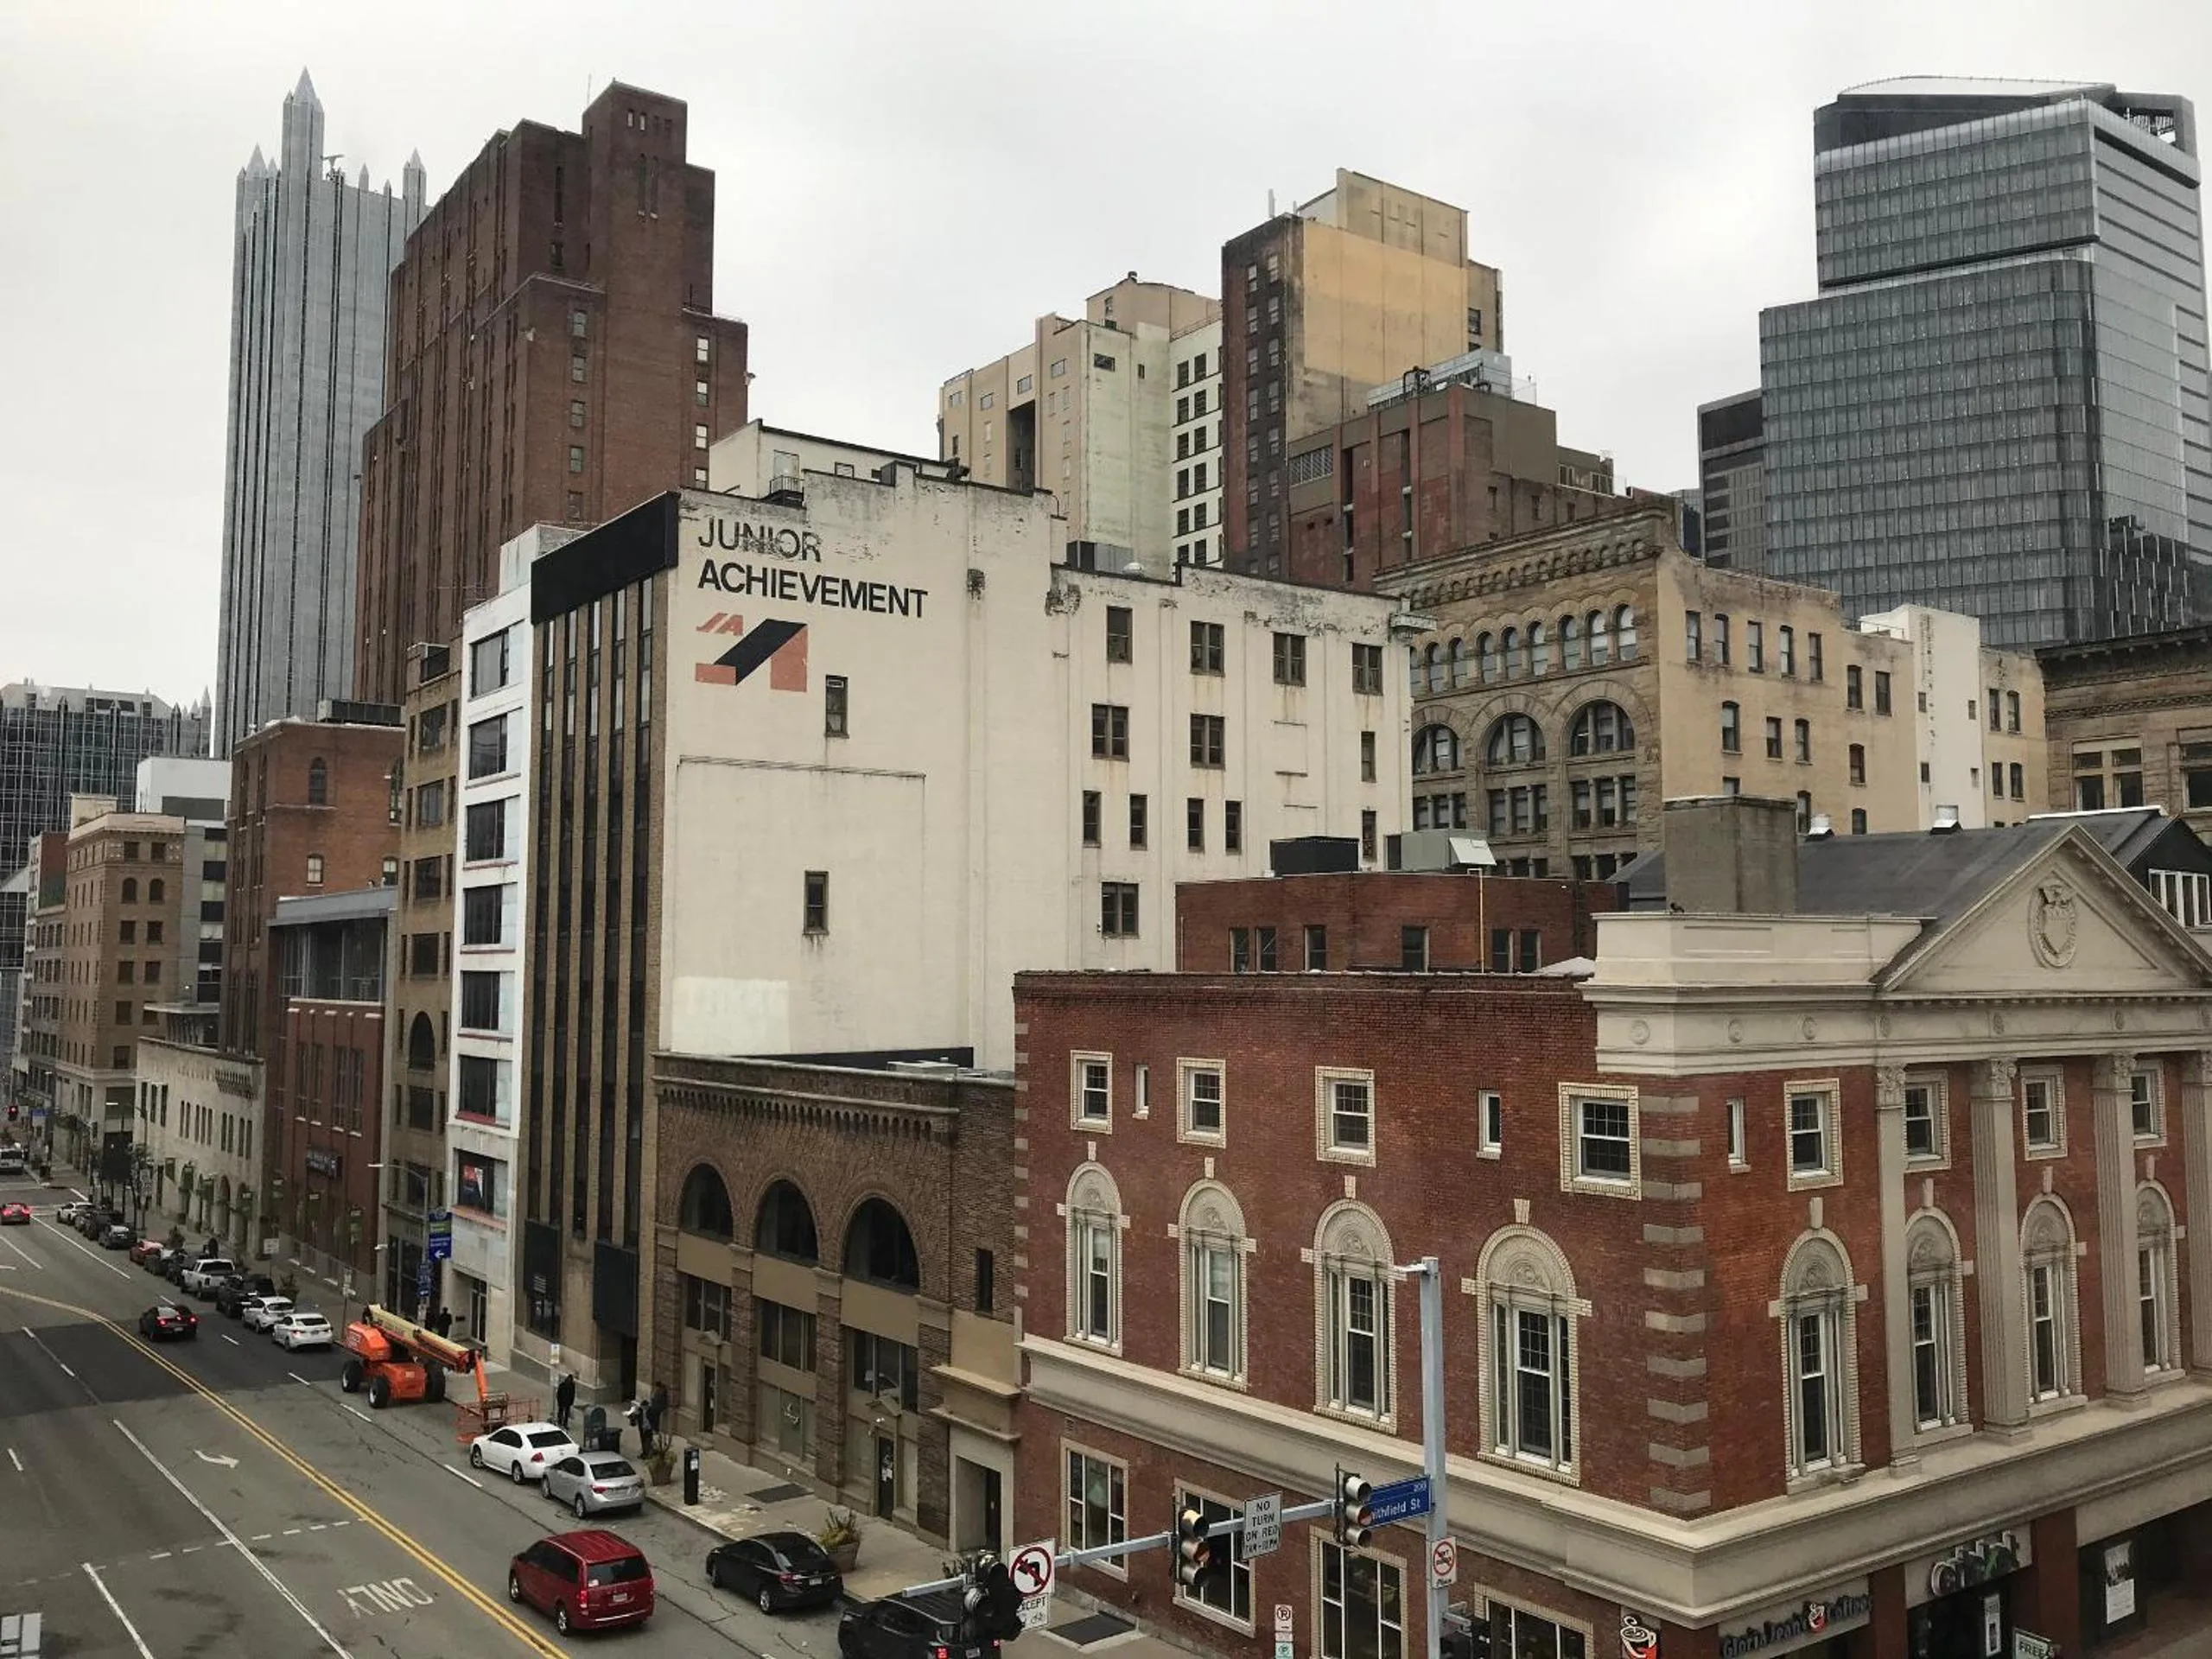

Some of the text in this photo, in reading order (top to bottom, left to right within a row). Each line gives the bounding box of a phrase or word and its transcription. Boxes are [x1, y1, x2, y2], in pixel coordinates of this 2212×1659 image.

[698, 518, 822, 563] JUNIOR
[697, 559, 928, 618] ACHIEVEMENT
[1256, 1501, 1270, 1512] NO
[1410, 1497, 1421, 1510] St
[1252, 1513, 1274, 1527] TURN
[1245, 1530, 1257, 1542] ON
[336, 1577, 433, 1618] ONLY
